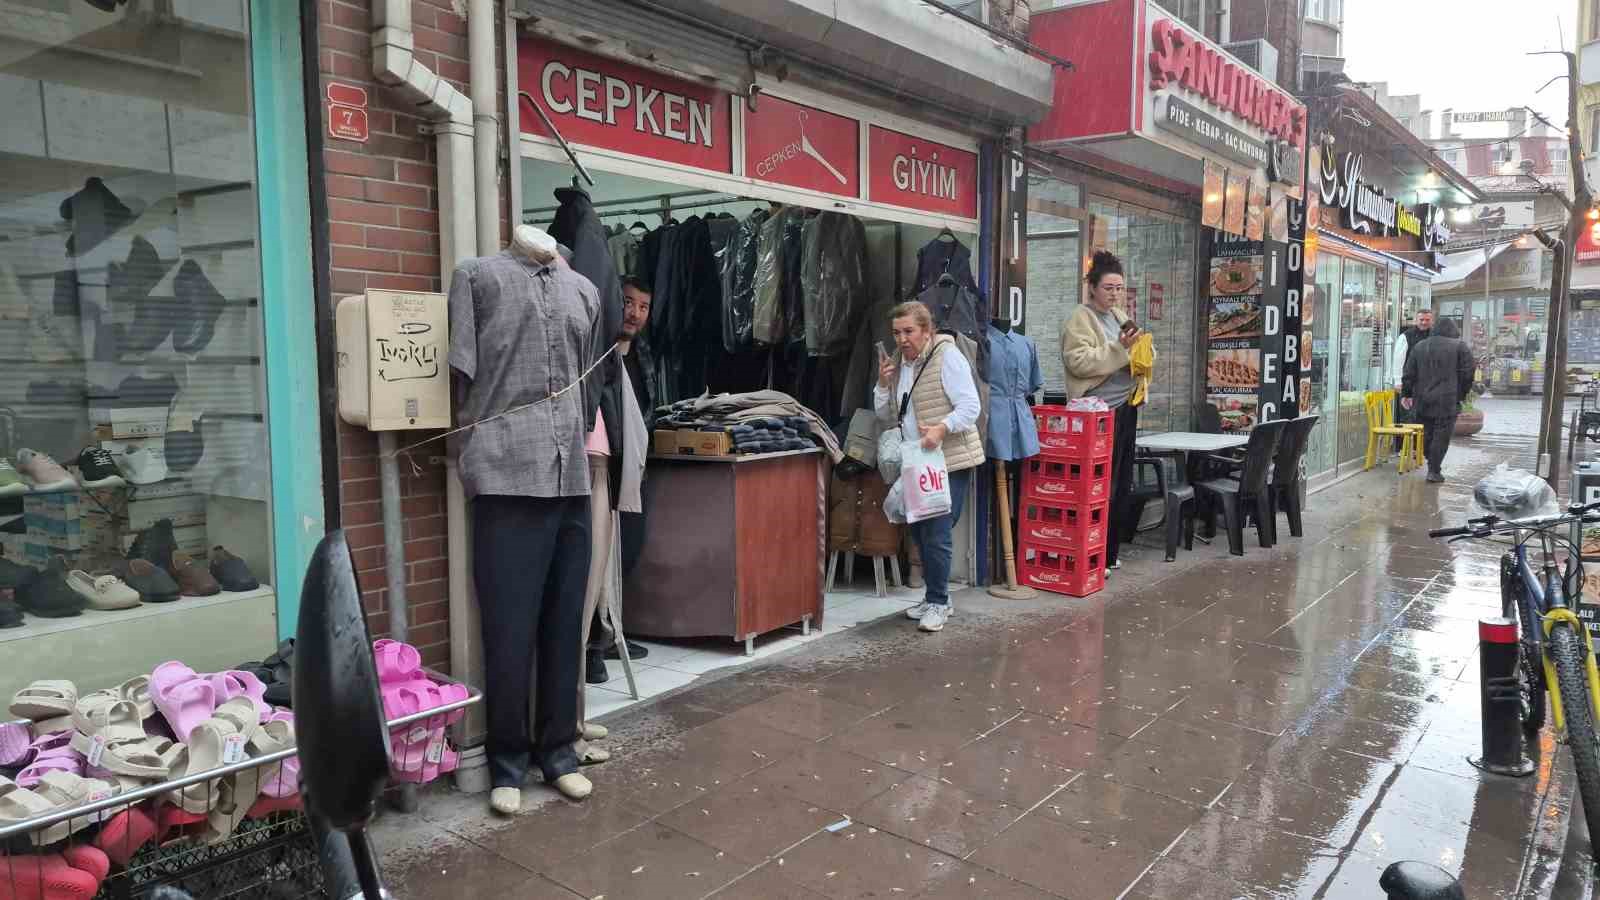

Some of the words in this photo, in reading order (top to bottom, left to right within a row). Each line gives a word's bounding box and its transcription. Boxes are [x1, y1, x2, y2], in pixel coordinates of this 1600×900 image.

[342, 111, 353, 125] 7
[541, 60, 713, 148] CEPKEN
[1170, 104, 1189, 127] PİDE
[1195, 118, 1220, 141] KEBAP
[755, 142, 802, 177] CEPKEN
[892, 146, 957, 201] GİYİM
[1010, 150, 1024, 328] PİD
